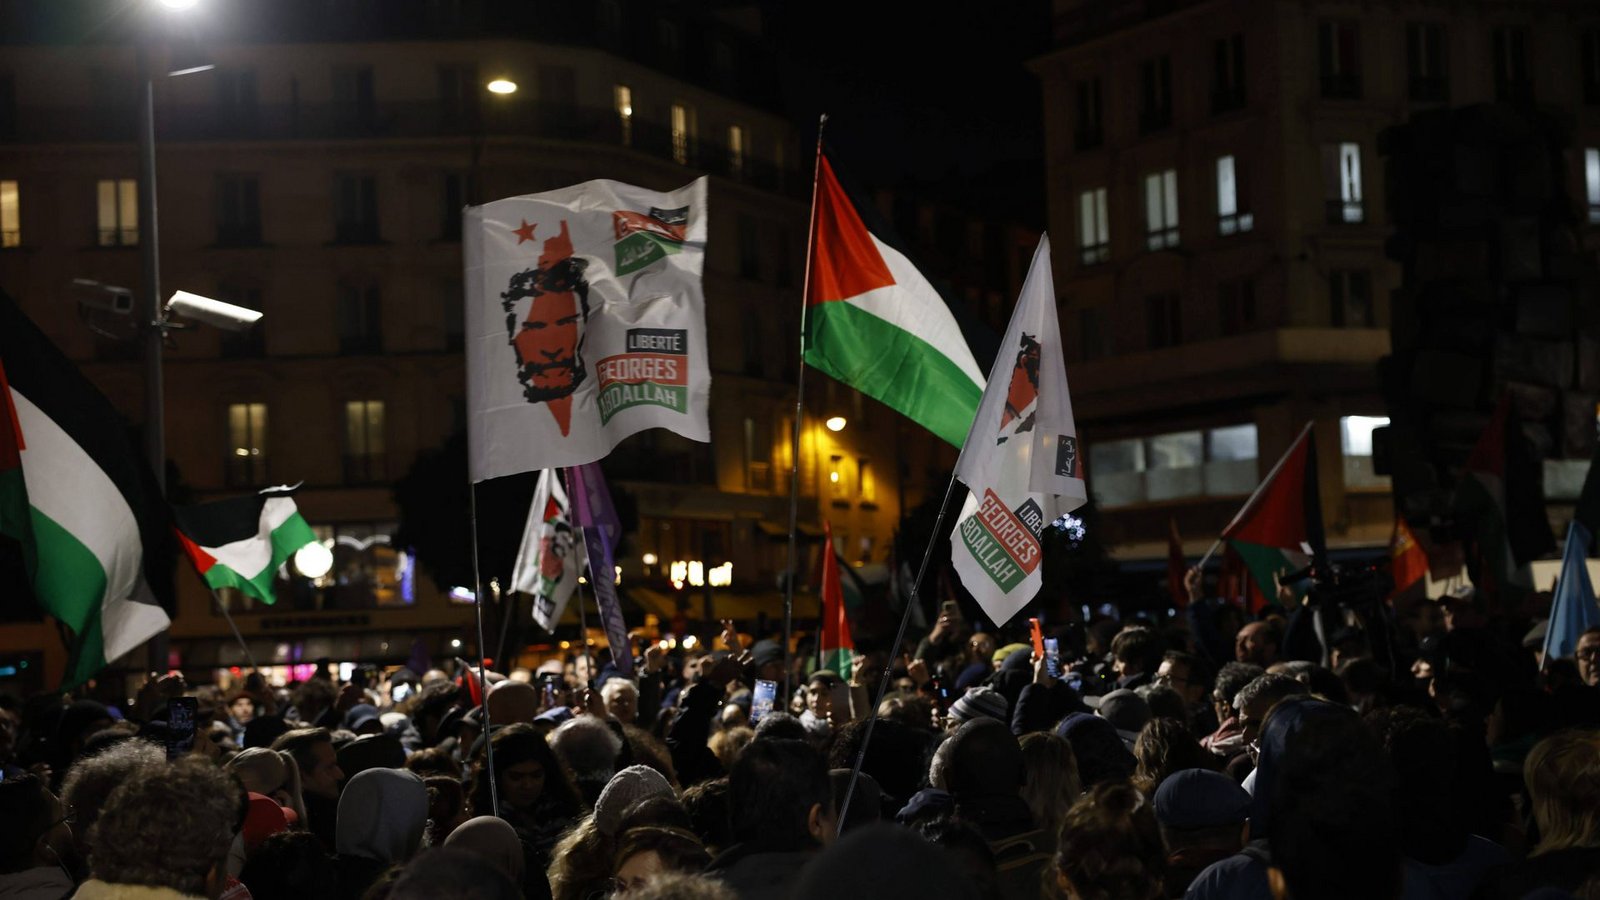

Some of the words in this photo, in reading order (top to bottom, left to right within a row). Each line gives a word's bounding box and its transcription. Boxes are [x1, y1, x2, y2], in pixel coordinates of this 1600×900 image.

[629, 332, 682, 351] LIBERTÉ
[598, 357, 677, 384] GEORGES
[600, 385, 677, 420] ABDALLAH
[980, 495, 1037, 563] GEORGES
